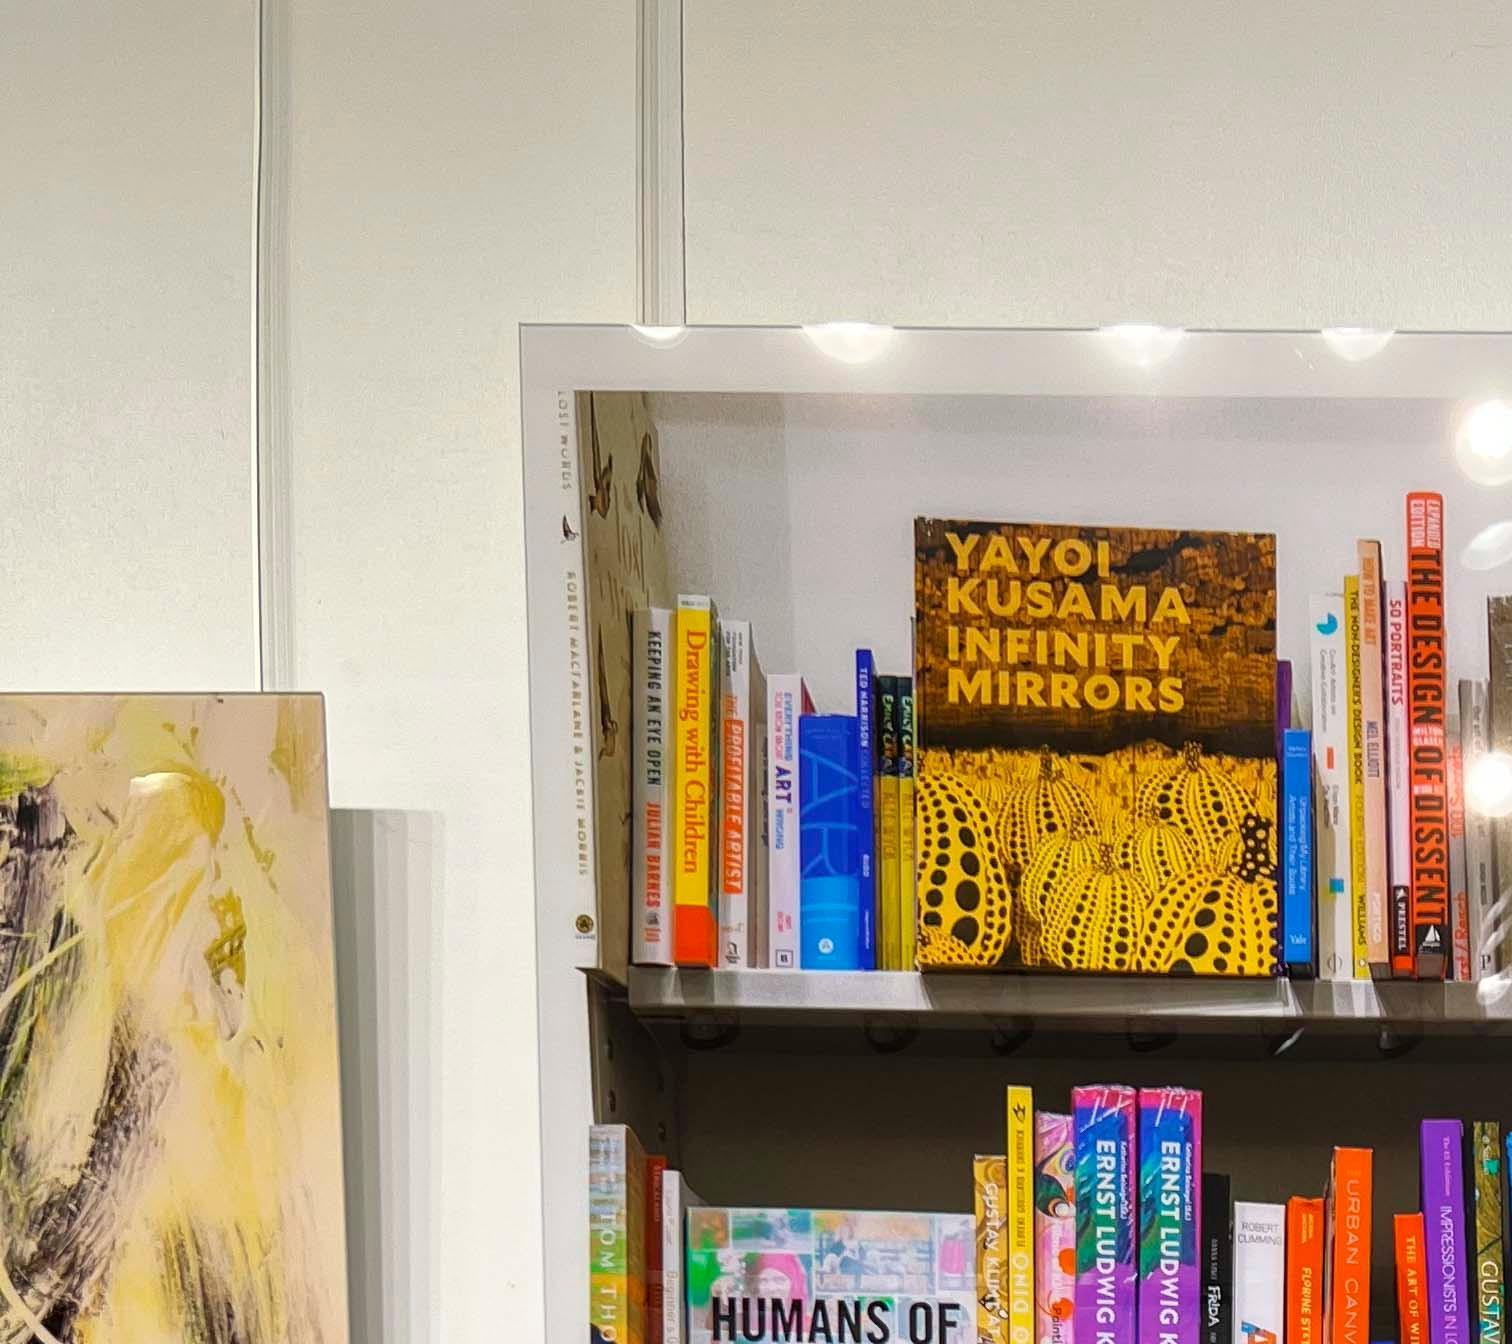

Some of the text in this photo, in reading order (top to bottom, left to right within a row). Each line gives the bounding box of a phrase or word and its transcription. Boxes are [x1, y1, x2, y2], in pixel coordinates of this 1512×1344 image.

[946, 532, 1109, 576] YAYOI
[948, 578, 1192, 626] KUSAMA
[948, 626, 1180, 671] INFINITY
[1389, 600, 1403, 706] 50 PORTRAITS
[647, 632, 661, 785] KEEPING AN EYE OPEN
[946, 669, 1184, 712] MIRRORS
[679, 629, 706, 874] Drawing with Children
[1410, 551, 1447, 925] THE DESIGN OF DISSENT
[645, 856, 661, 907] BARNES
[1096, 1141, 1115, 1219] ERNST
[1160, 1141, 1180, 1220] ERNST
[599, 1213, 616, 1269] TOM
[1346, 1179, 1360, 1265] URBAN
[1096, 1226, 1116, 1324] LUDWIG
[1160, 1226, 1179, 1324] LUDWIG
